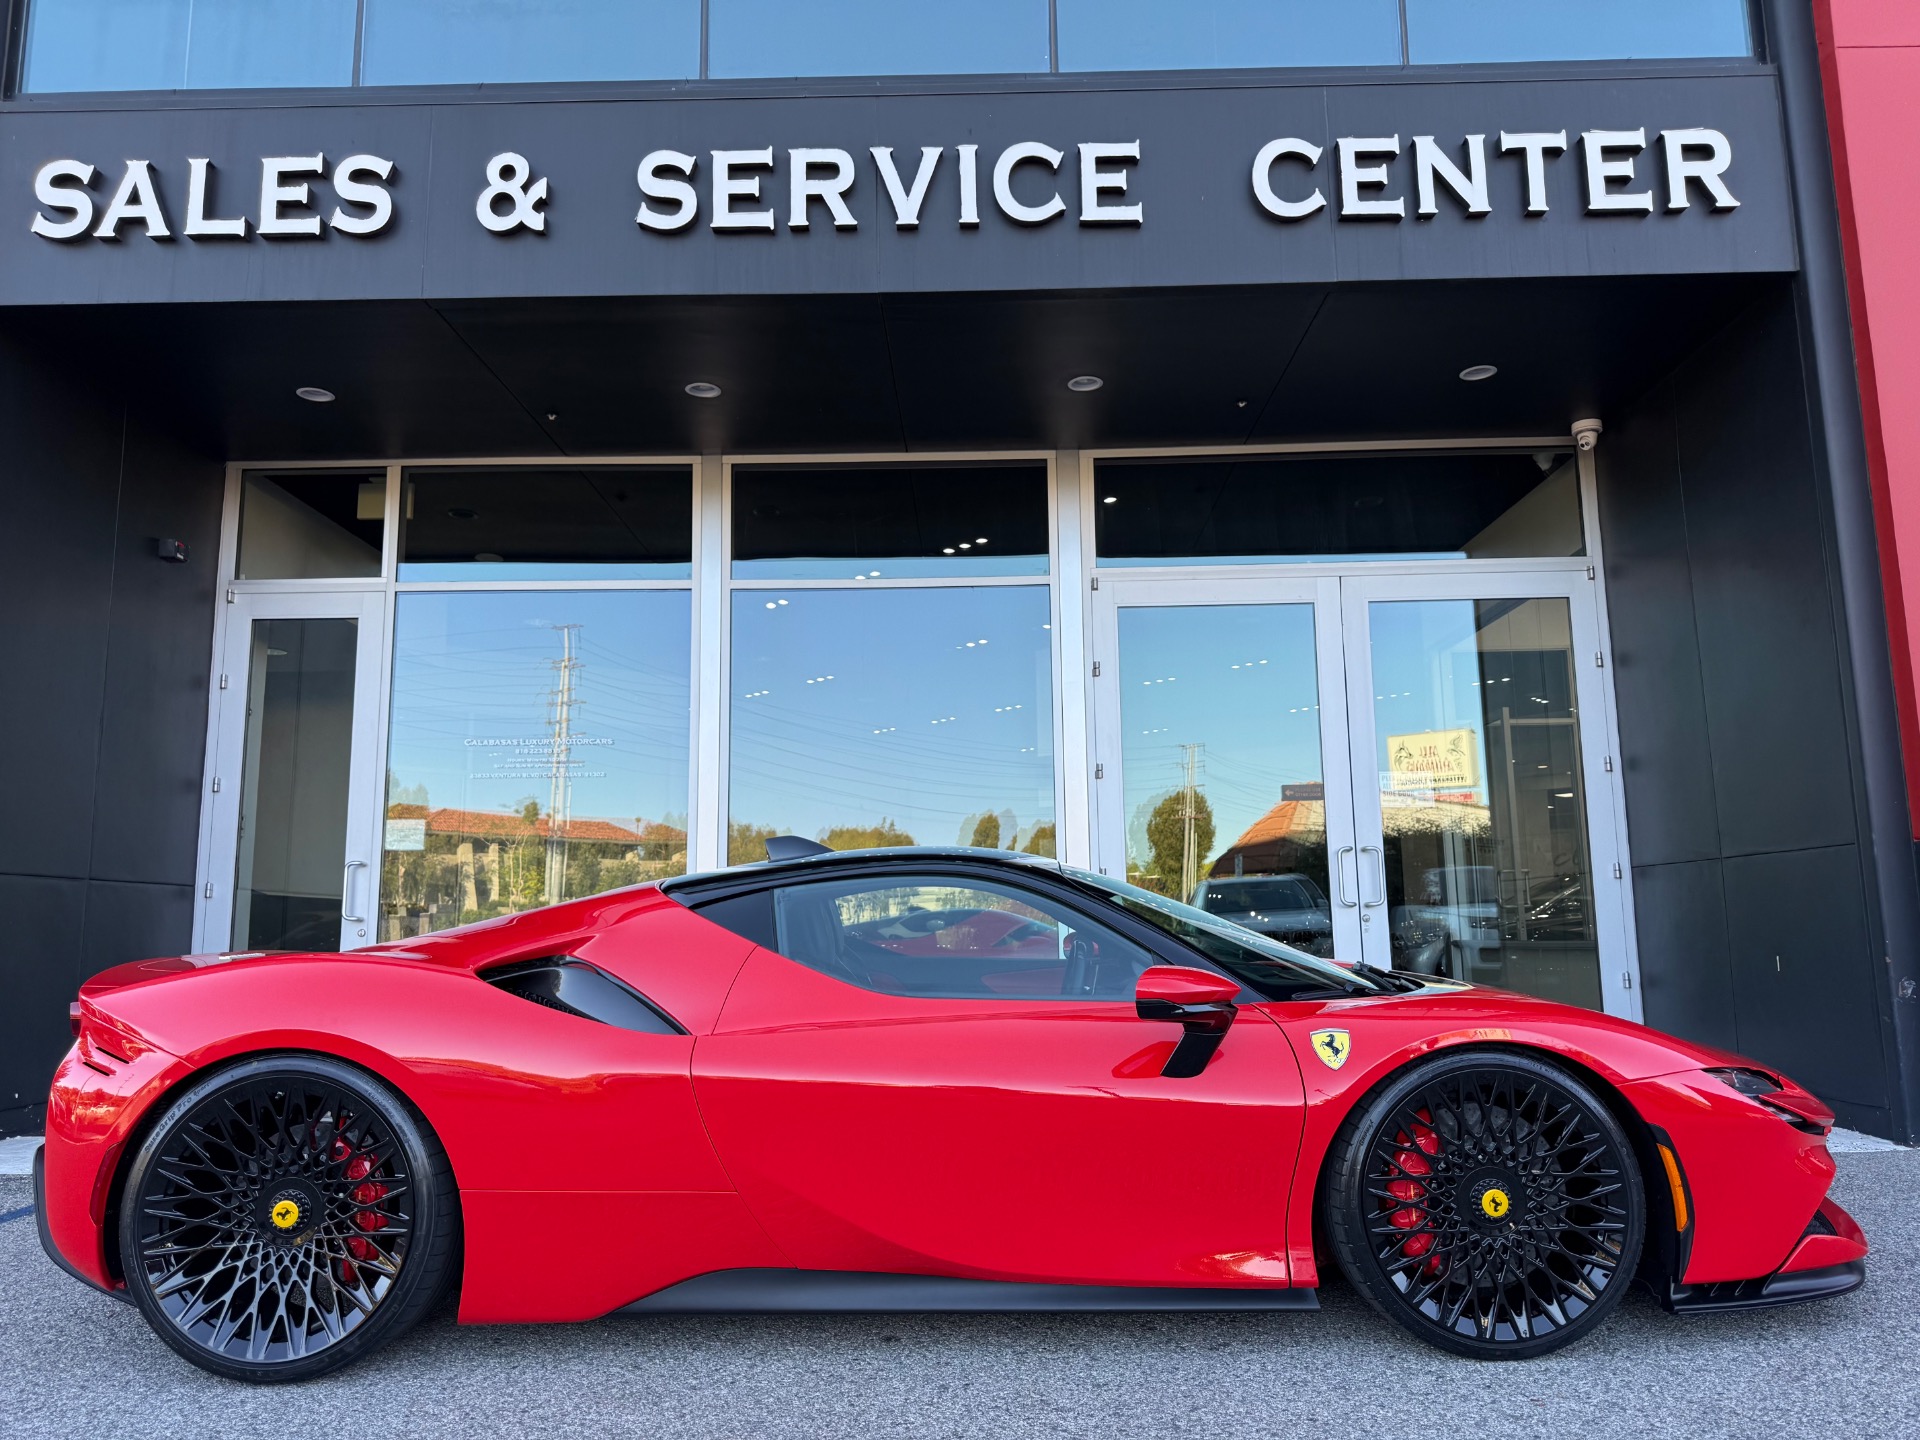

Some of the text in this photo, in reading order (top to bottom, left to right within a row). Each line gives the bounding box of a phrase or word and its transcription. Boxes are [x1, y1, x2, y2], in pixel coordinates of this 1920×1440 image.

[30, 127, 1742, 241] SALES & SERVICE CENTER
[464, 738, 614, 746] CALABASAS LUXURY MOTORCARS
